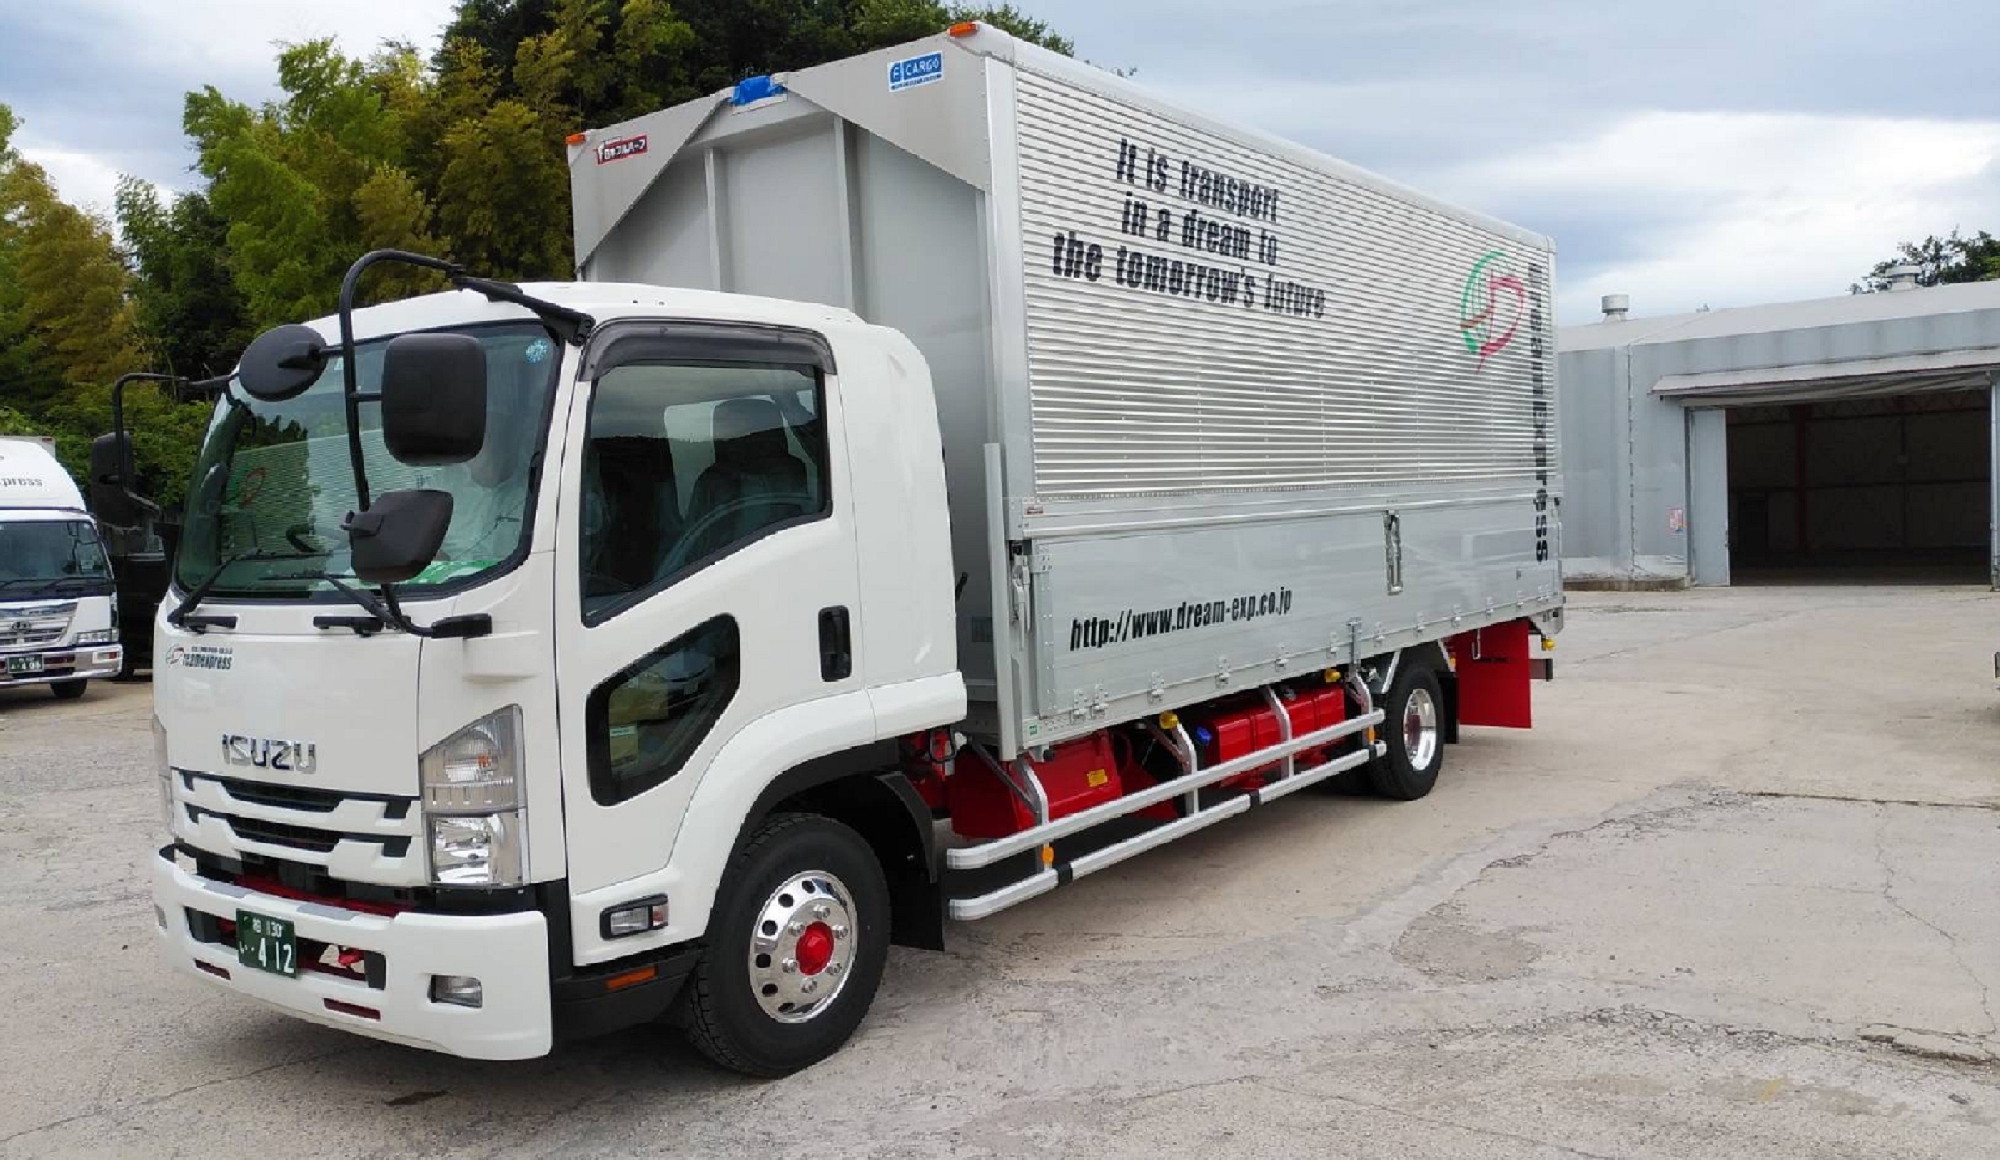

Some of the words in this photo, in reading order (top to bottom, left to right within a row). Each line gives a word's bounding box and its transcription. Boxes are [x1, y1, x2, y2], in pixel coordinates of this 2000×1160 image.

[905, 57, 940, 76] CARGO
[1117, 138, 1137, 185] It
[1146, 147, 1169, 194] is
[1179, 160, 1279, 222] transport
[1122, 190, 1148, 237] in
[1157, 208, 1171, 242] a
[1182, 208, 1250, 261] dream
[1259, 228, 1278, 267] to
[1053, 230, 1103, 282] the
[1117, 245, 1256, 308] tomorrow's
[1264, 272, 1326, 318] future
[1069, 586, 1293, 652] http://www.dream-exp.co.jp
[222, 733, 317, 775] ISUZU
